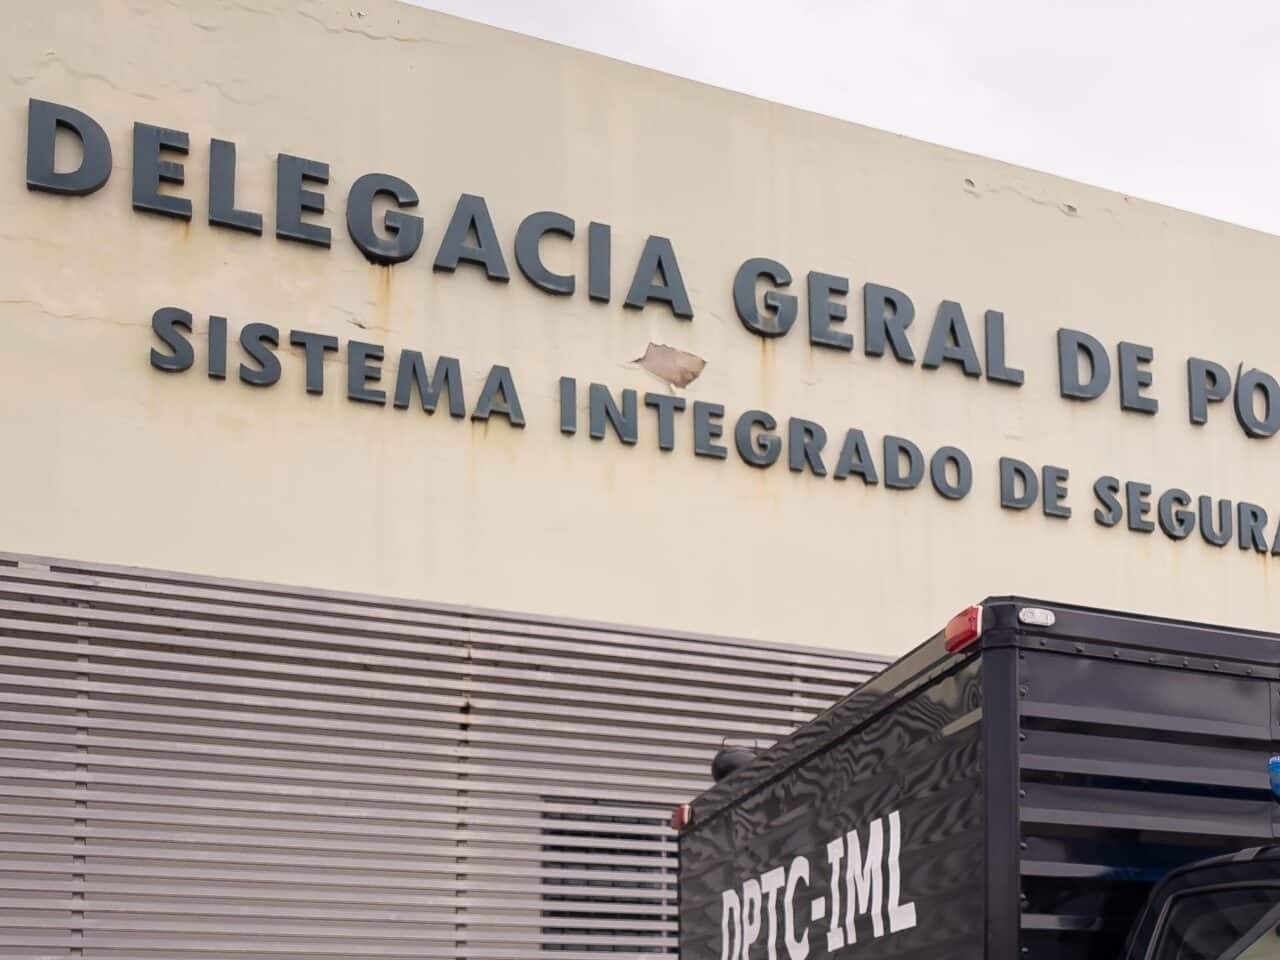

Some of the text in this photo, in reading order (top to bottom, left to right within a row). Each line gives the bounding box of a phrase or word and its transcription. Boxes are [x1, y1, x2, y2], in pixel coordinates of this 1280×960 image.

[26, 98, 693, 322] DELEGACIA
[733, 258, 1024, 388] GERAL
[1057, 329, 1158, 416] DE
[150, 307, 526, 430] SISTEMA
[559, 377, 972, 501] INTEGRADO
[1000, 458, 1072, 520] DE
